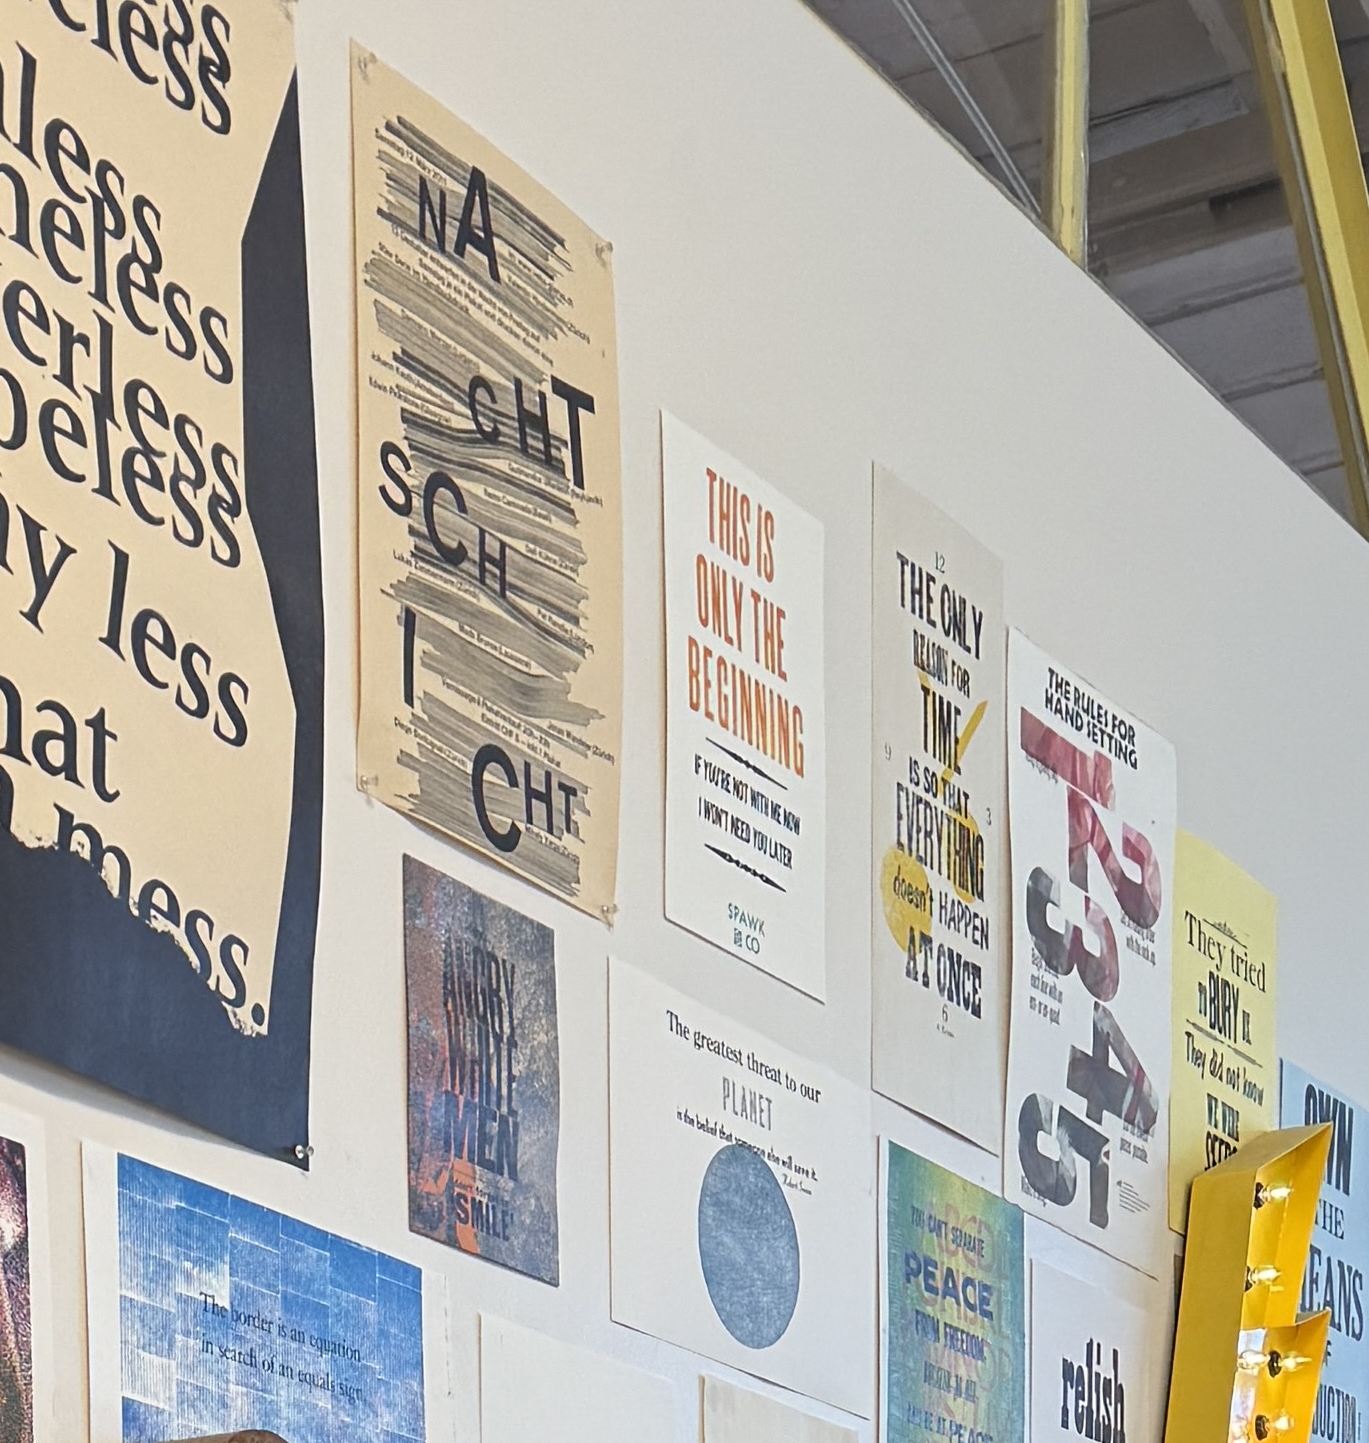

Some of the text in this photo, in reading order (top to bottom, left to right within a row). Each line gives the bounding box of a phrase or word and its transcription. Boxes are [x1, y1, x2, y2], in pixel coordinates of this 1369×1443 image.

[707, 467, 774, 584] THIS IS
[696, 554, 788, 679] ONLY THE
[896, 552, 983, 660] THE ONLY
[688, 635, 805, 779] BEGINNING
[920, 682, 962, 774] TIME
[1044, 689, 1138, 770] HAND SETTING
[1047, 666, 1136, 747] THE RULES FOR
[896, 782, 984, 902] EVERYTHING
[939, 890, 989, 950] HAPPEN
[1185, 909, 1266, 992] They tried
[905, 927, 981, 1020] AT ONCE
[666, 1011, 821, 1102] The greatest threat to our
[722, 1076, 773, 1131] PLANET
[200, 1292, 228, 1319] The
[310, 1332, 361, 1362] equation
